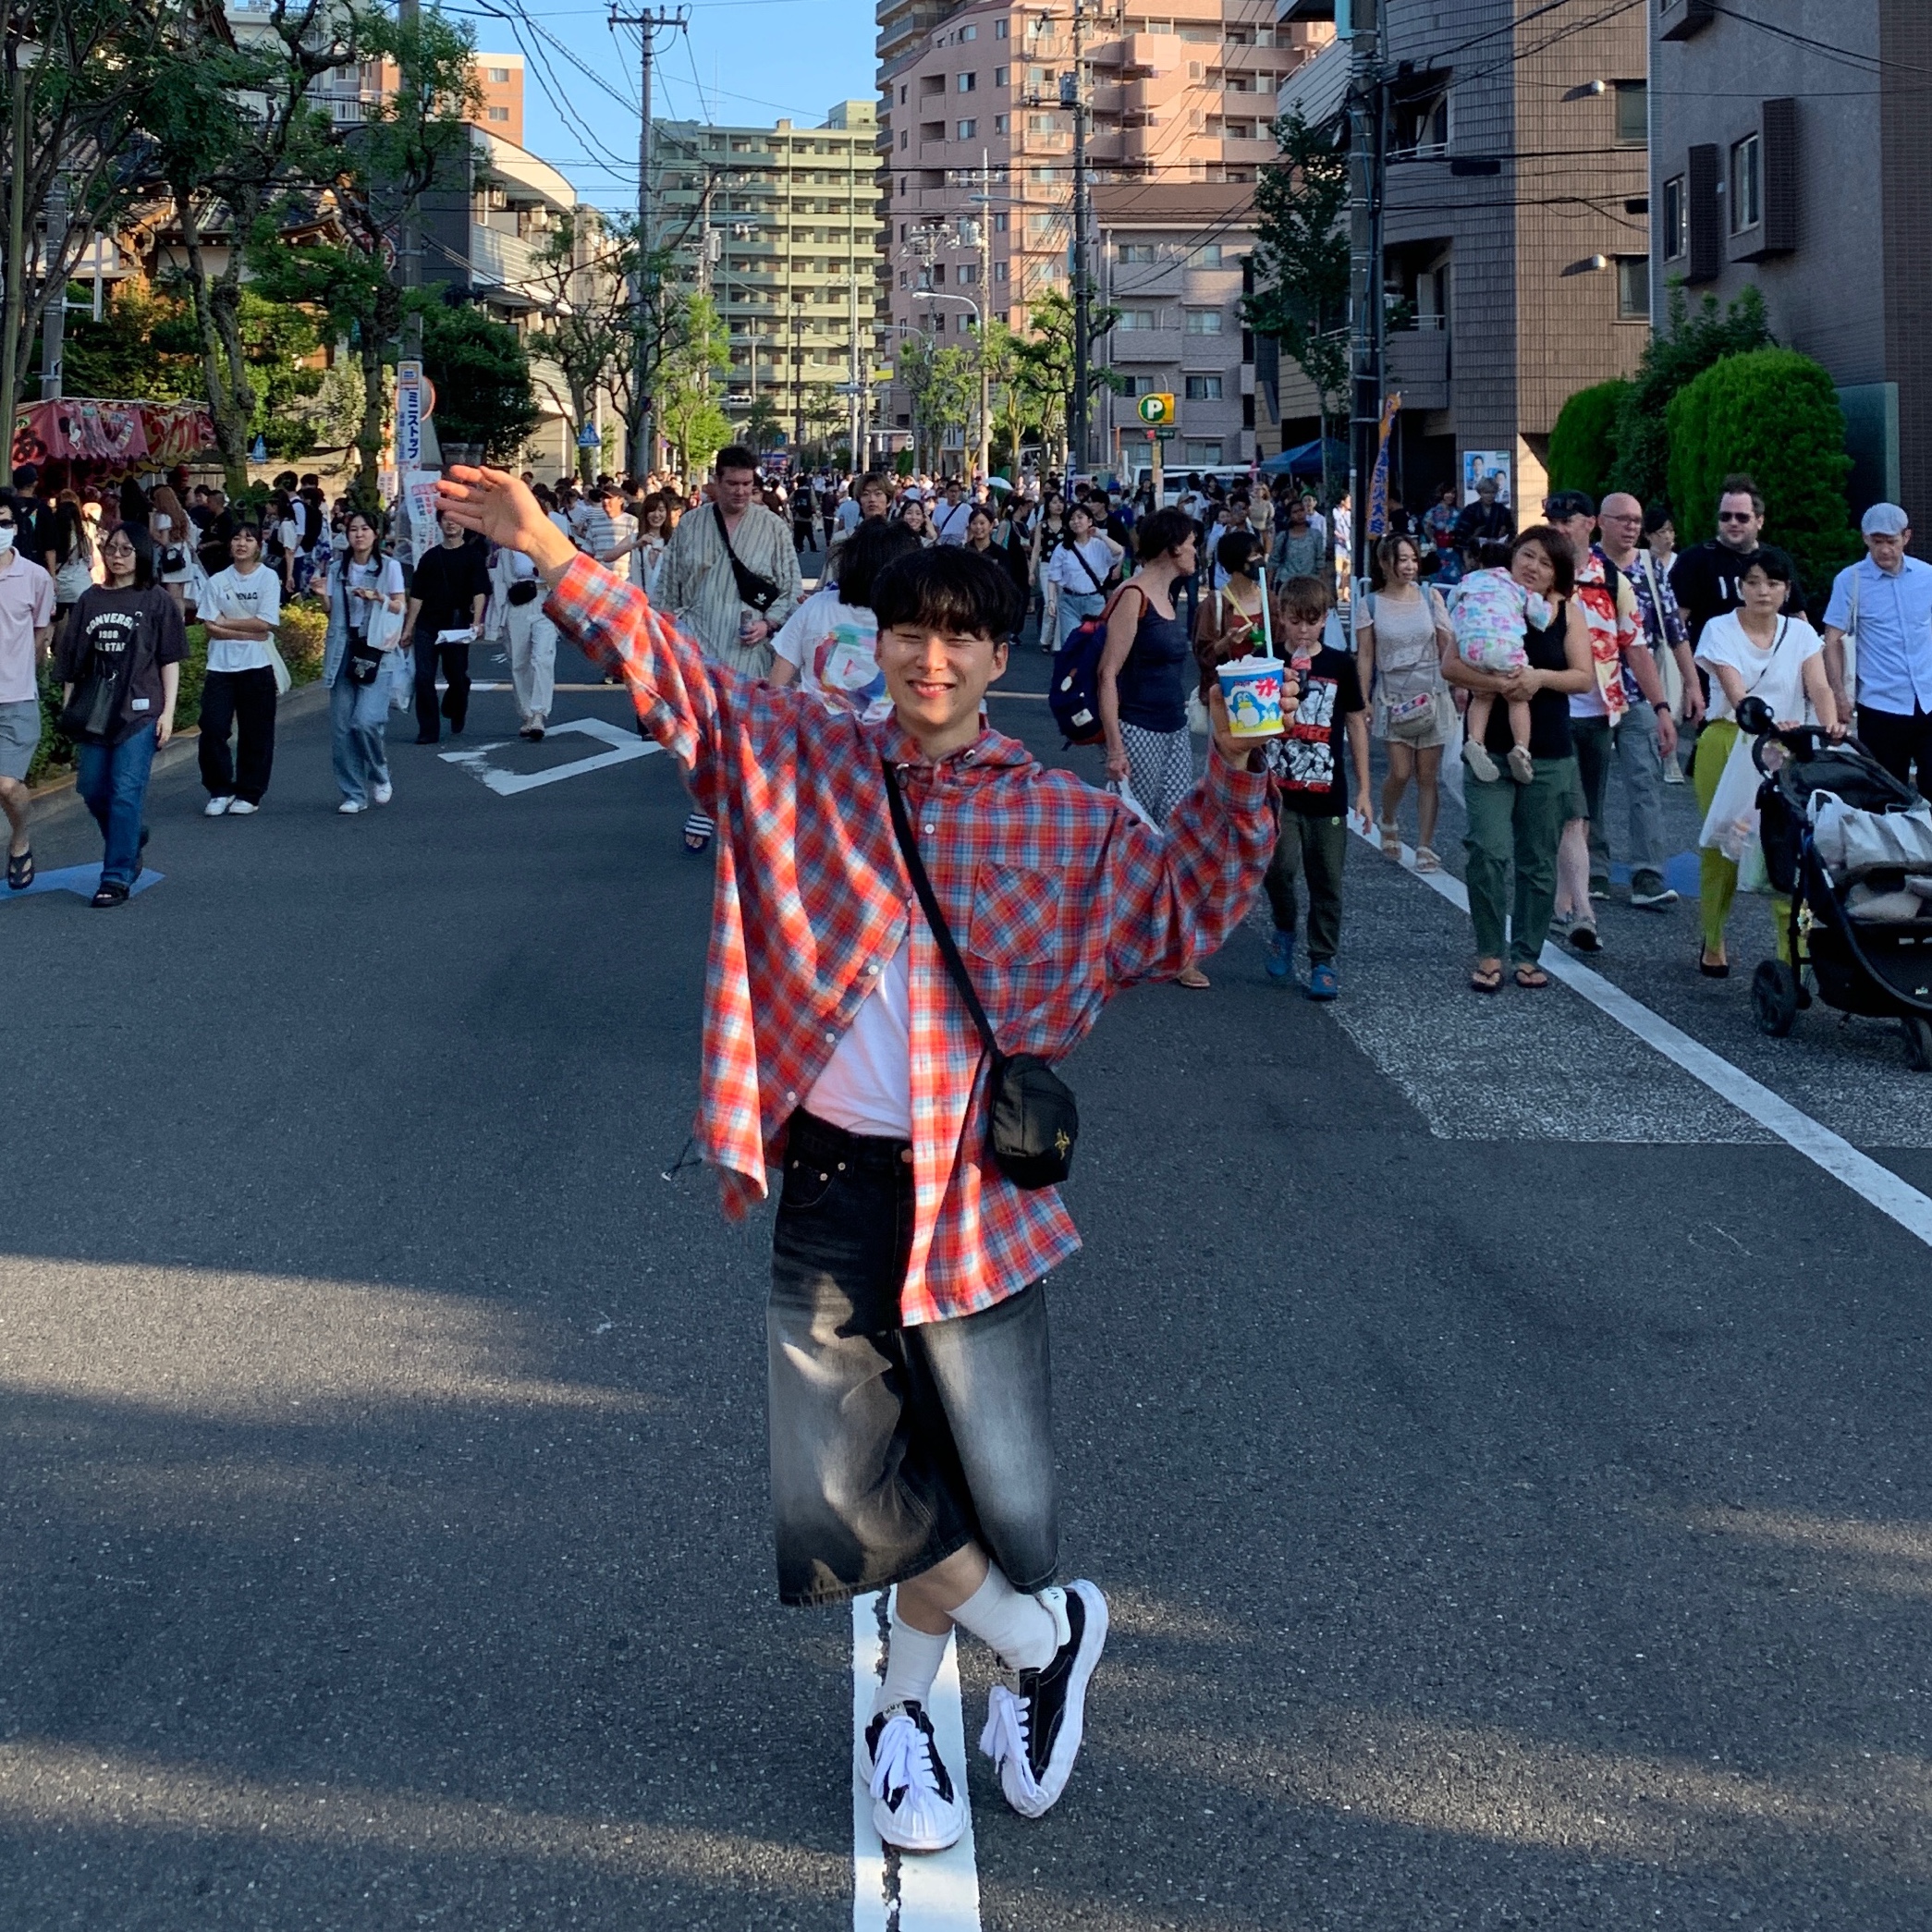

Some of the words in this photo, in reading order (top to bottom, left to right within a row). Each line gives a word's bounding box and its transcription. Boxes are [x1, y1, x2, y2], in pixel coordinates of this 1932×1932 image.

[1146, 399, 1164, 420] P
[408, 391, 419, 459] ミニストップ
[1254, 677, 1278, 698] 氷
